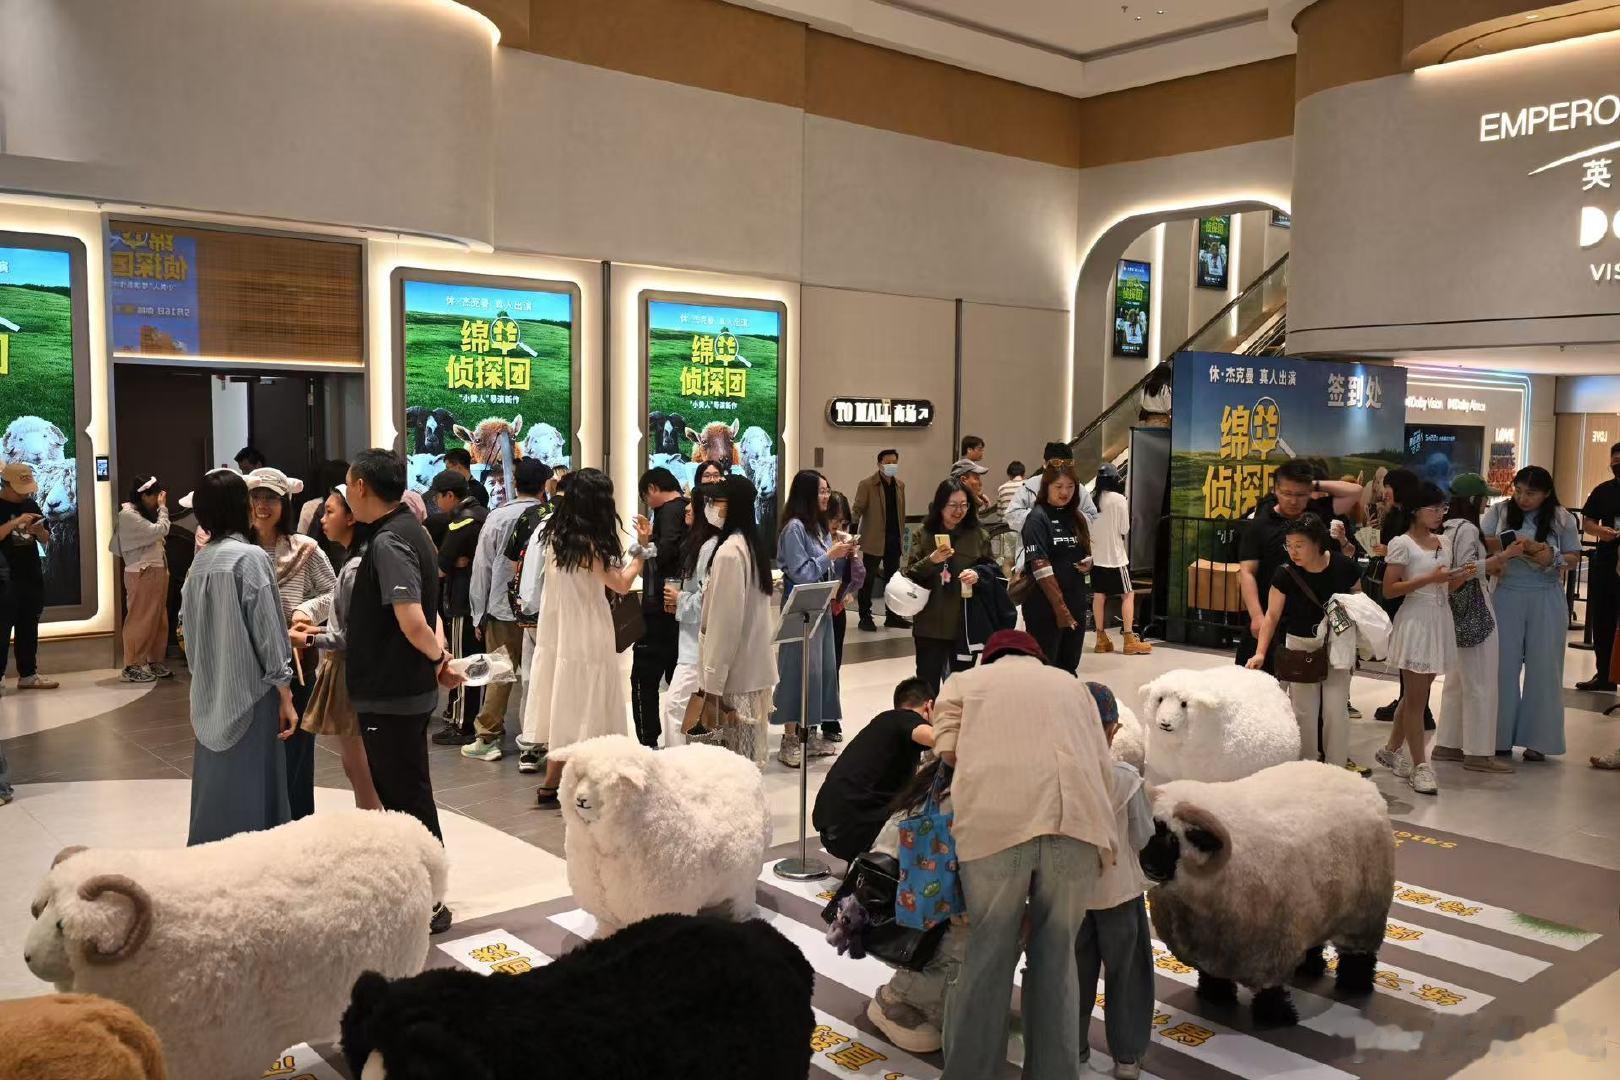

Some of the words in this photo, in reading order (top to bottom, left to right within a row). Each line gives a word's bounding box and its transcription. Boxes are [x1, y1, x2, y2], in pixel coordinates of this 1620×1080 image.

[1479, 94, 1620, 142] EMPERO
[1582, 158, 1613, 191] 英
[1580, 206, 1620, 247] D
[459, 318, 520, 356] 绵羊
[691, 333, 738, 366] 绵羊
[445, 354, 532, 391] 侦探团
[679, 366, 747, 398] 侦探团
[1209, 364, 1255, 385] 休·杰克曼
[1259, 368, 1297, 386] 真人出演
[1327, 373, 1383, 410] 签到处
[835, 401, 854, 422] TO
[854, 402, 892, 423] MALL
[893, 404, 917, 423] 商场
[1219, 402, 1280, 461] 绵羊
